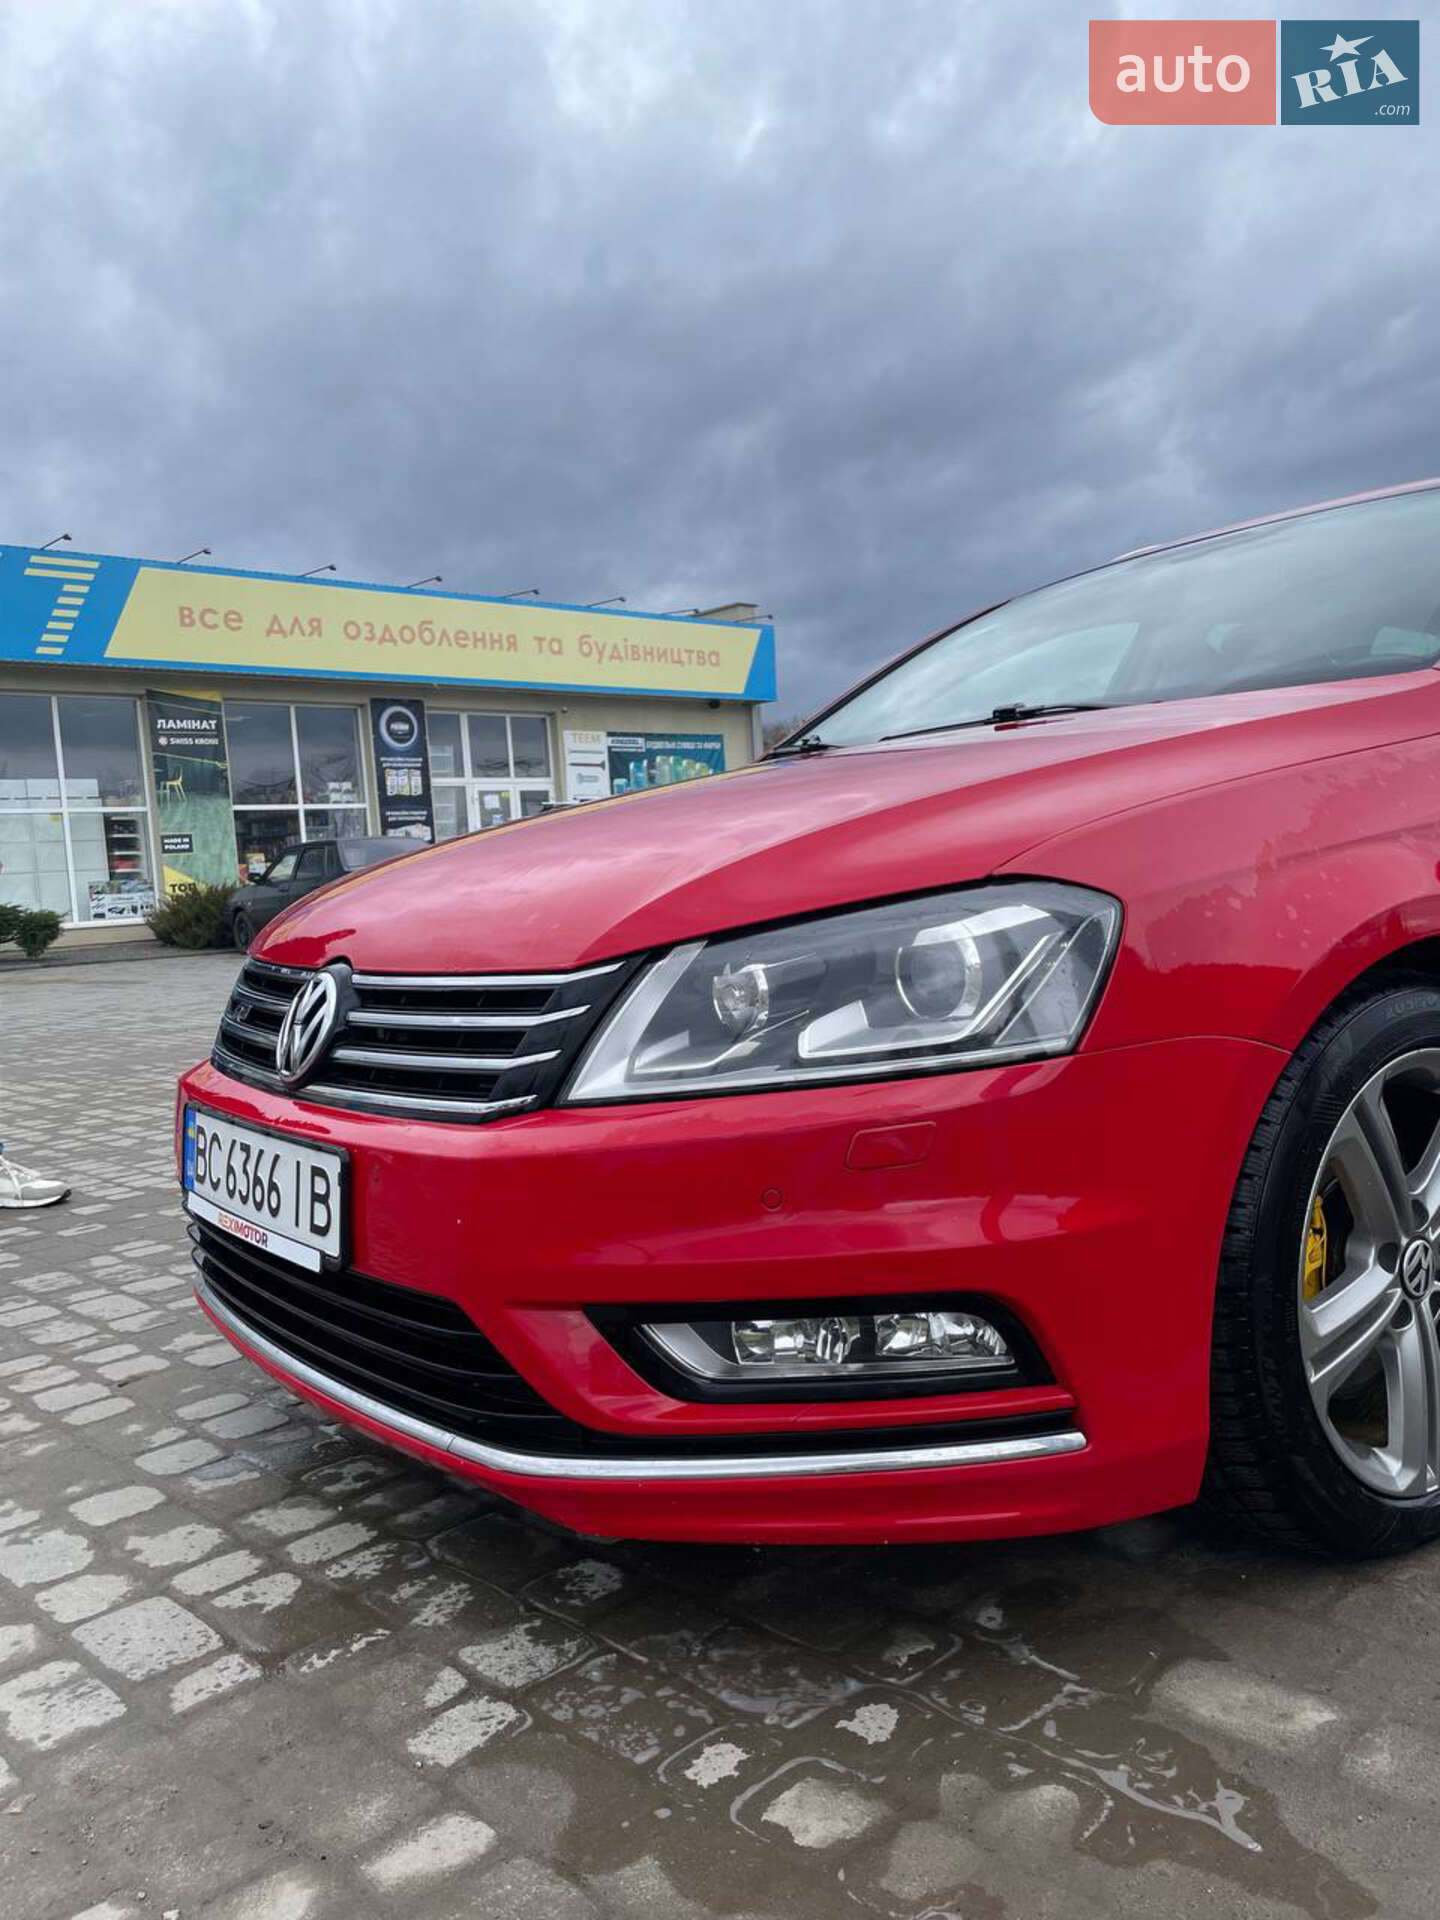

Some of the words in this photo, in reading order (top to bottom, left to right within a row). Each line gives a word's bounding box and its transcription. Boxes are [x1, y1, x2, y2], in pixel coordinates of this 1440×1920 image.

[178, 605, 243, 631] все
[265, 614, 323, 638] для
[343, 619, 518, 652] оздоблення
[533, 635, 563, 655] та
[579, 634, 720, 667] будівництва
[157, 719, 217, 730] ЛАМІНАТ
